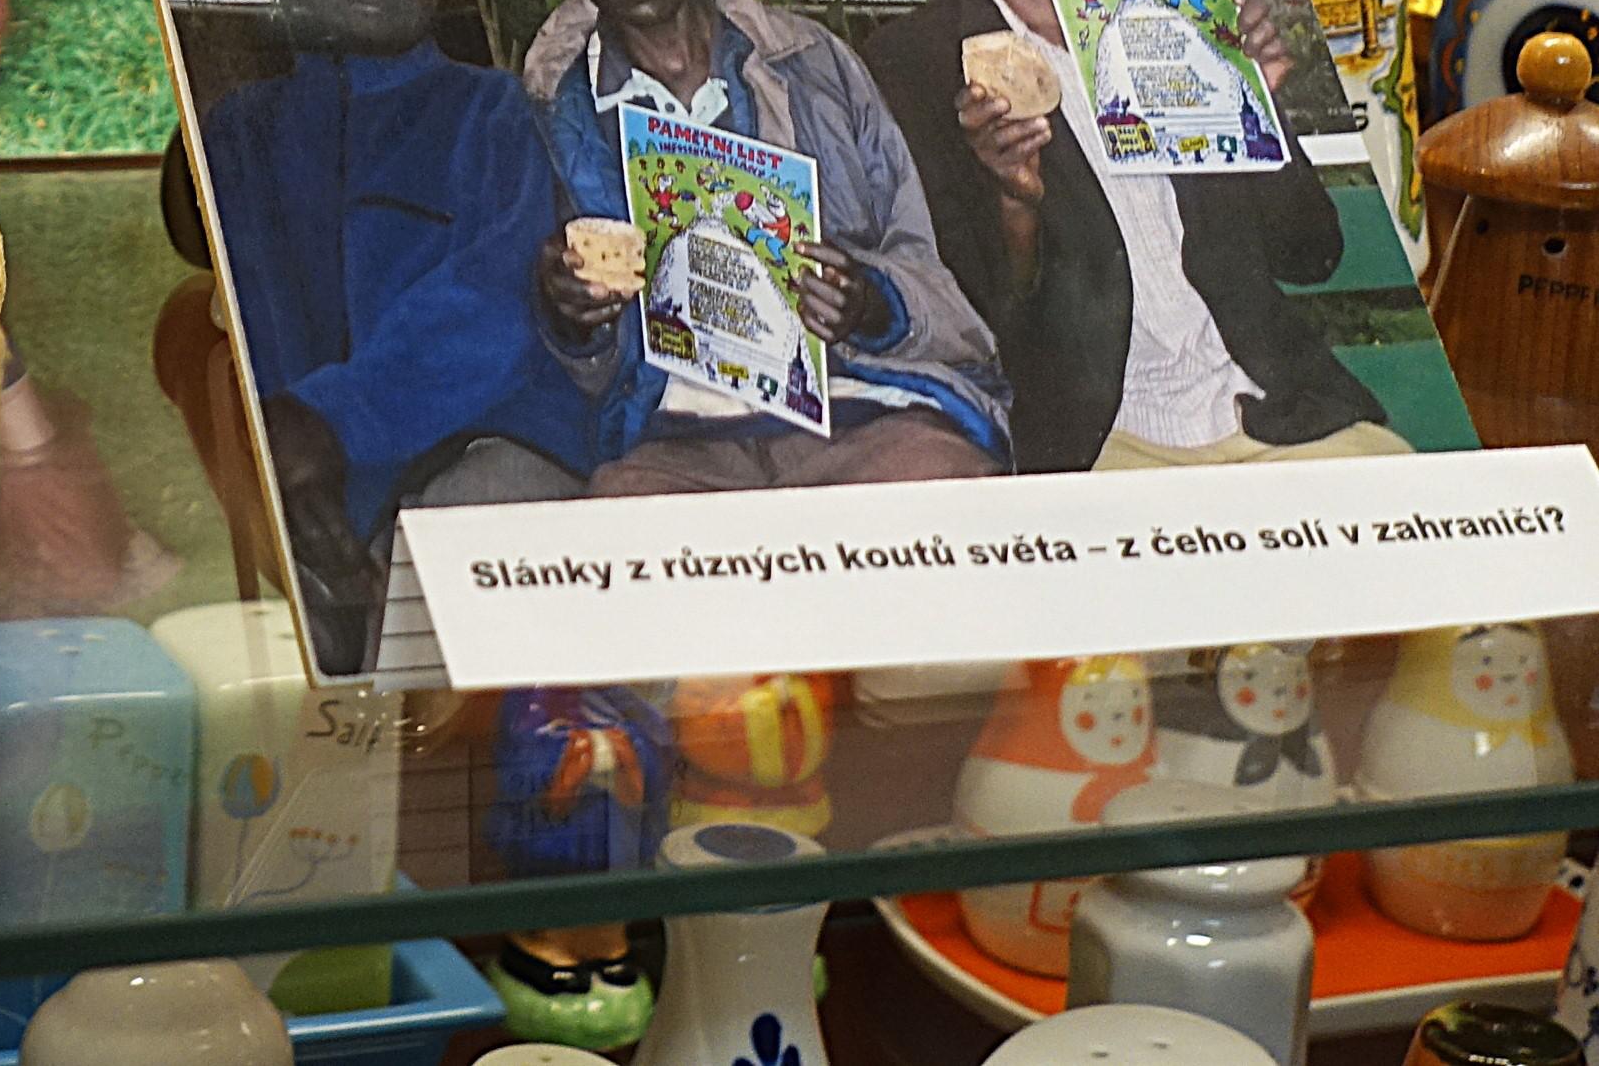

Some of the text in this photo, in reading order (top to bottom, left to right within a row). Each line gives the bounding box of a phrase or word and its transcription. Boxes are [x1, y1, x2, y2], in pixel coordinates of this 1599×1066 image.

[736, 139, 783, 171] LIST
[470, 555, 613, 591] Slánky
[627, 560, 651, 581] z
[662, 544, 828, 583] různých
[836, 534, 957, 571] koutů
[966, 533, 1079, 566] světa
[1117, 536, 1142, 559] z
[1150, 524, 1248, 557] čeho
[1257, 519, 1330, 551] solí
[1338, 524, 1360, 546] v
[1371, 505, 1566, 543] zahraničí?
